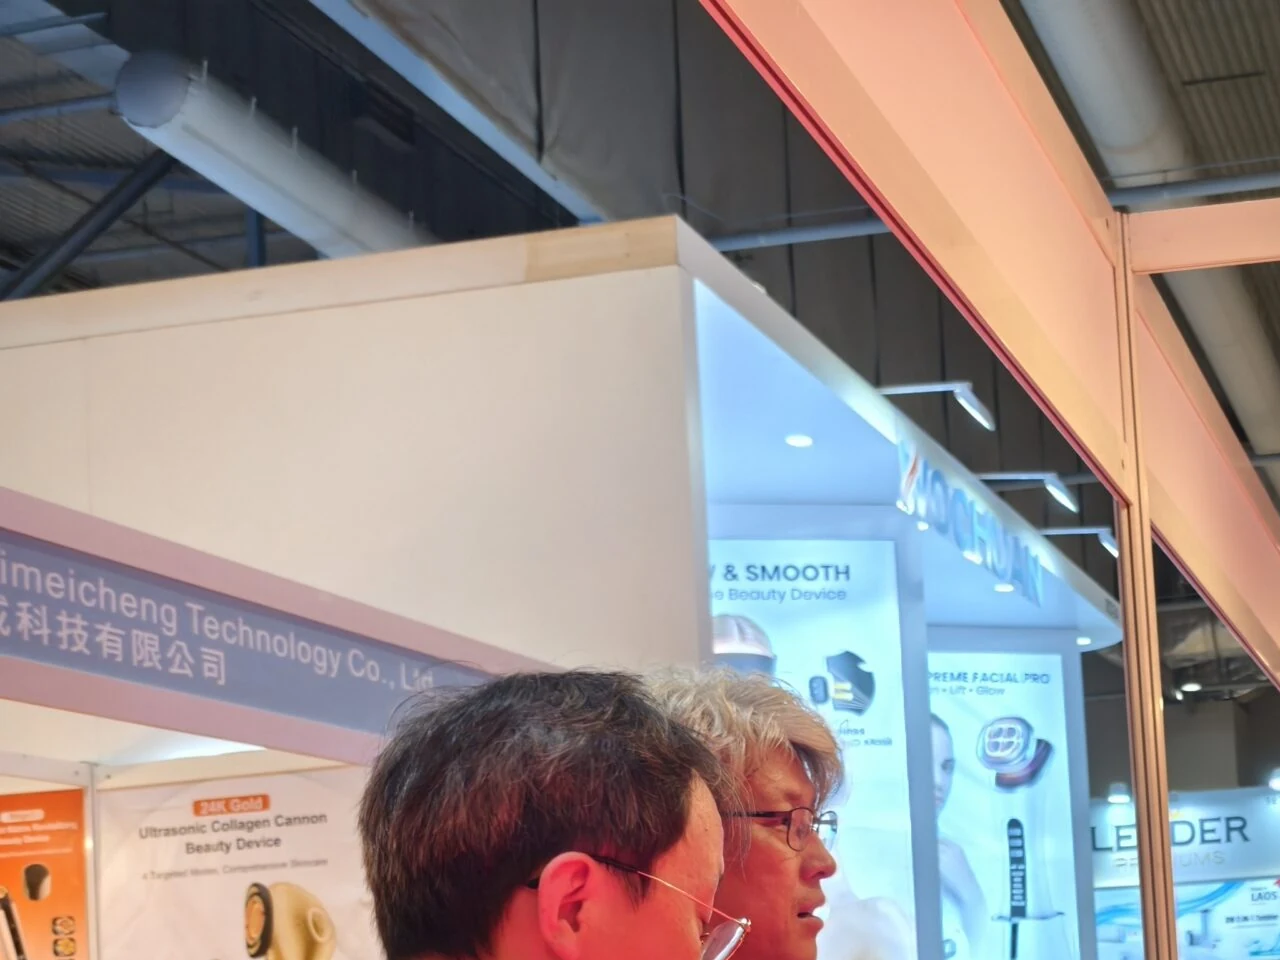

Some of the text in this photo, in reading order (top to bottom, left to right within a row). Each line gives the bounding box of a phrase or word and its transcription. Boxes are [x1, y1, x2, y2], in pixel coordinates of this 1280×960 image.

[746, 564, 850, 581] SMOOTH
[729, 588, 786, 604] Beauty
[791, 588, 847, 600] Device
[0, 551, 177, 636] imeicheng
[186, 602, 341, 677] Technology
[348, 648, 395, 690] Co.,
[972, 672, 1019, 684] FACIAL
[1024, 673, 1051, 684] PRO
[139, 813, 327, 839] Ultrasonic Collagen Cannon
[1090, 816, 1250, 851] LEDER
[185, 836, 281, 855] Beauty Device
